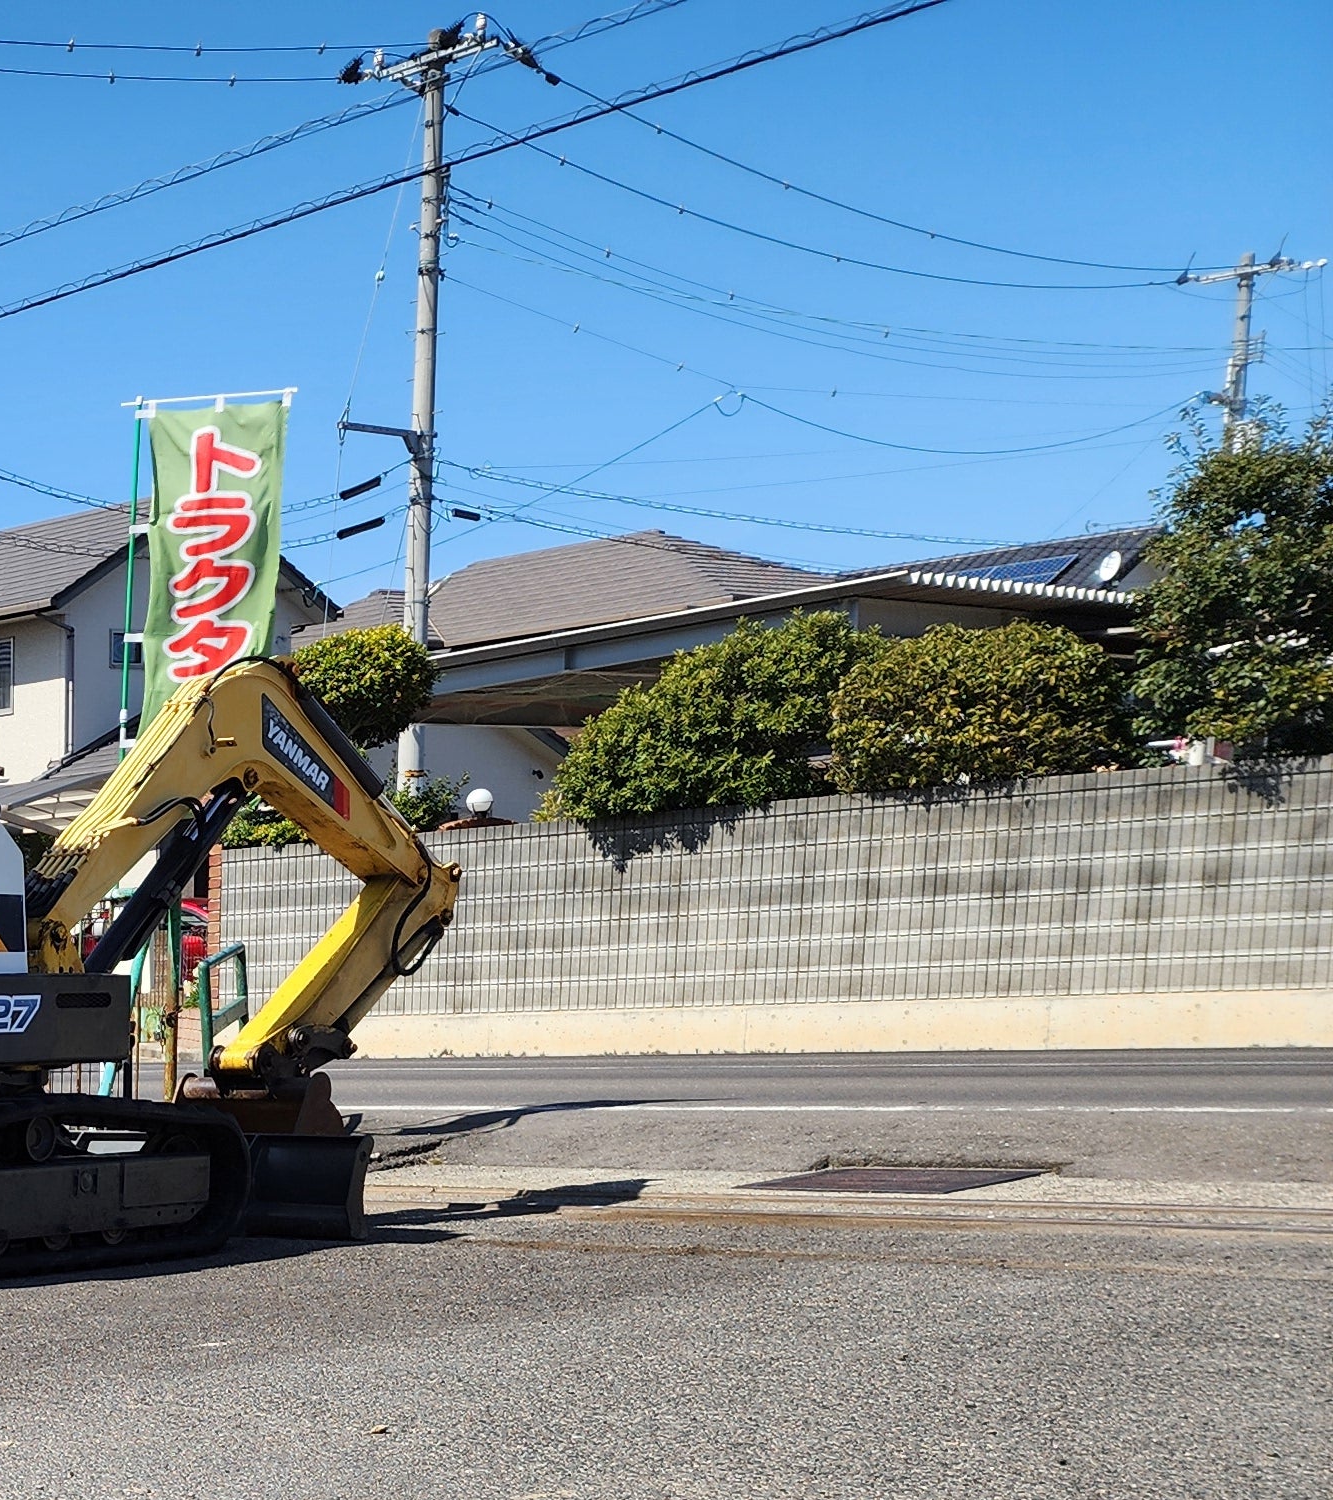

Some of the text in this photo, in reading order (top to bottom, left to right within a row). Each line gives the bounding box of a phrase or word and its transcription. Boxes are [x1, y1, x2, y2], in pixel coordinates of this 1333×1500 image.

[163, 426, 262, 683] トラクタ
[267, 718, 330, 792] YANMAR
